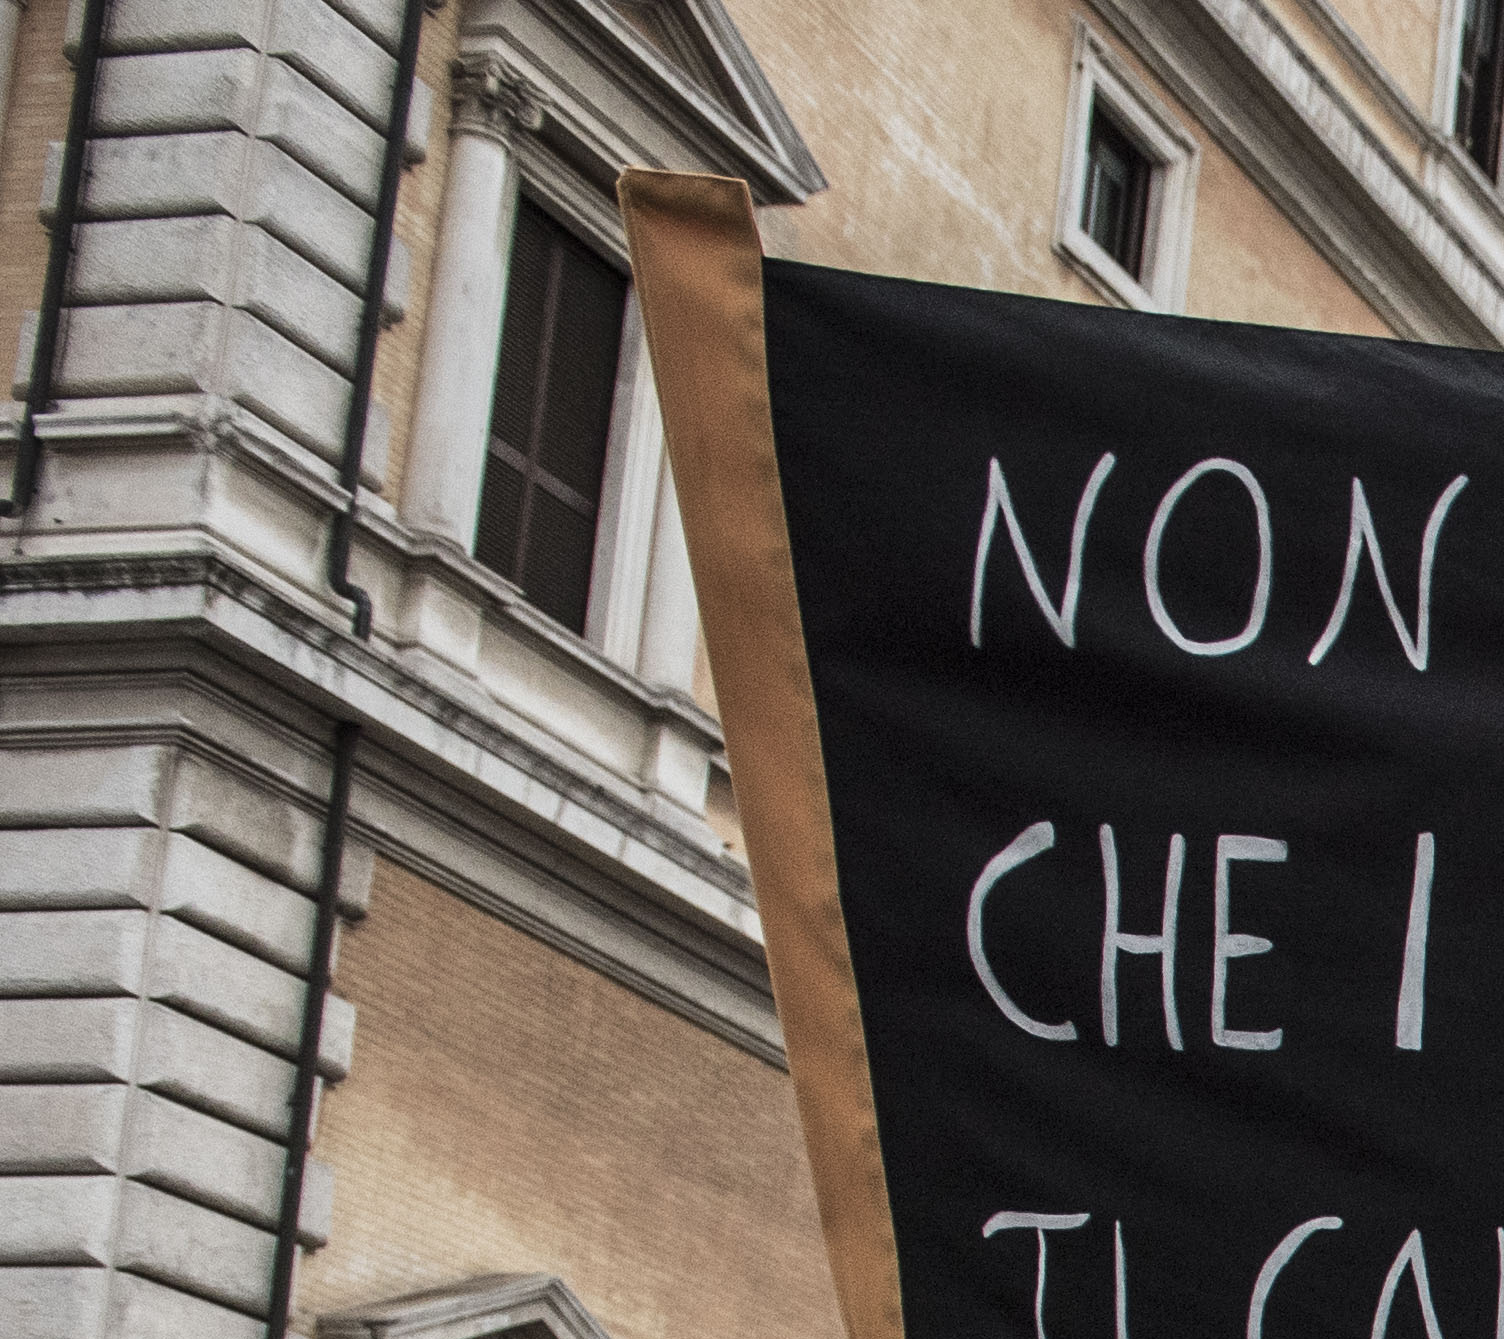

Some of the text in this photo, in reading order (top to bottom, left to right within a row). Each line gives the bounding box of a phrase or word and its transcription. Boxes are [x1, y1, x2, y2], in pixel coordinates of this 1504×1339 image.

[970, 452, 1469, 671] NON
[966, 820, 1289, 1052] CHE
[1395, 831, 1436, 1051] I
